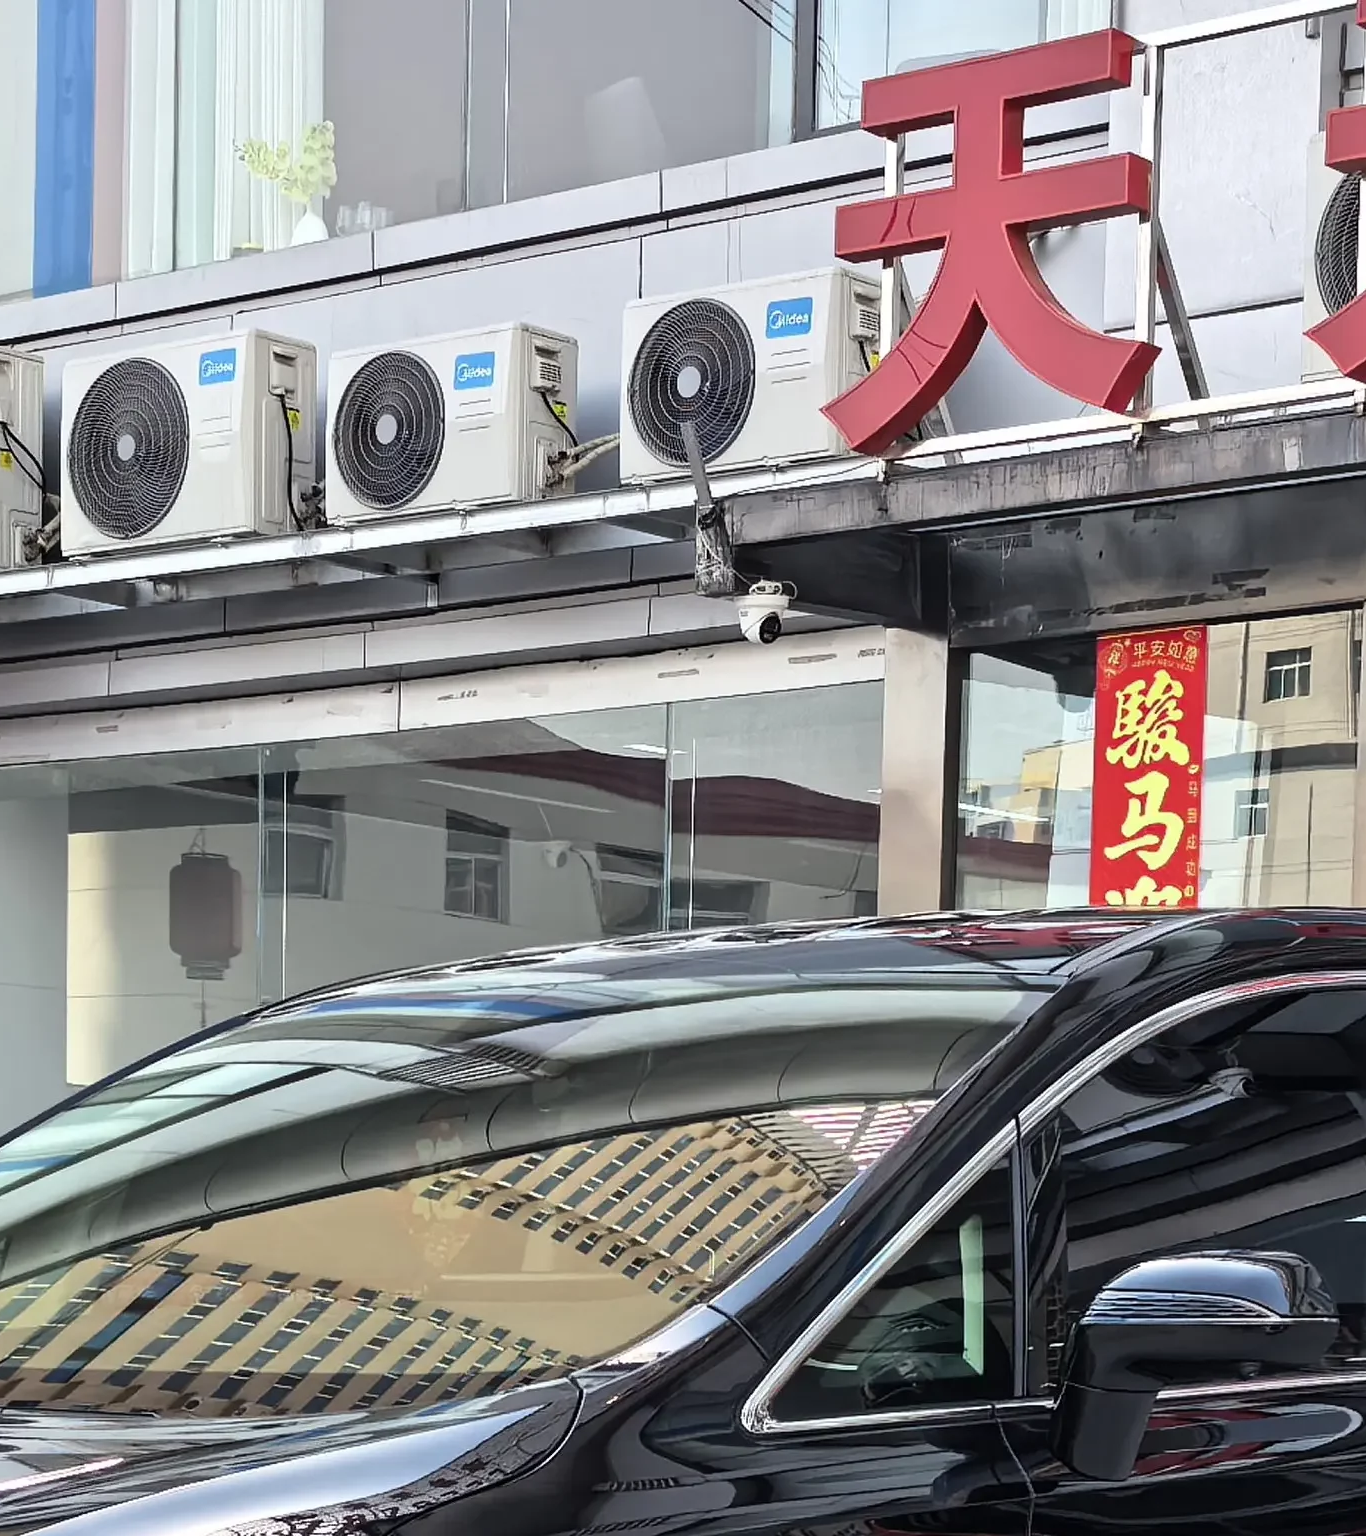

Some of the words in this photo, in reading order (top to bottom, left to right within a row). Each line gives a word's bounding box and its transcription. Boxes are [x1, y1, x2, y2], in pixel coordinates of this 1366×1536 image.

[769, 309, 809, 330] Midea
[201, 359, 235, 379] Midea
[457, 363, 492, 381] Midea
